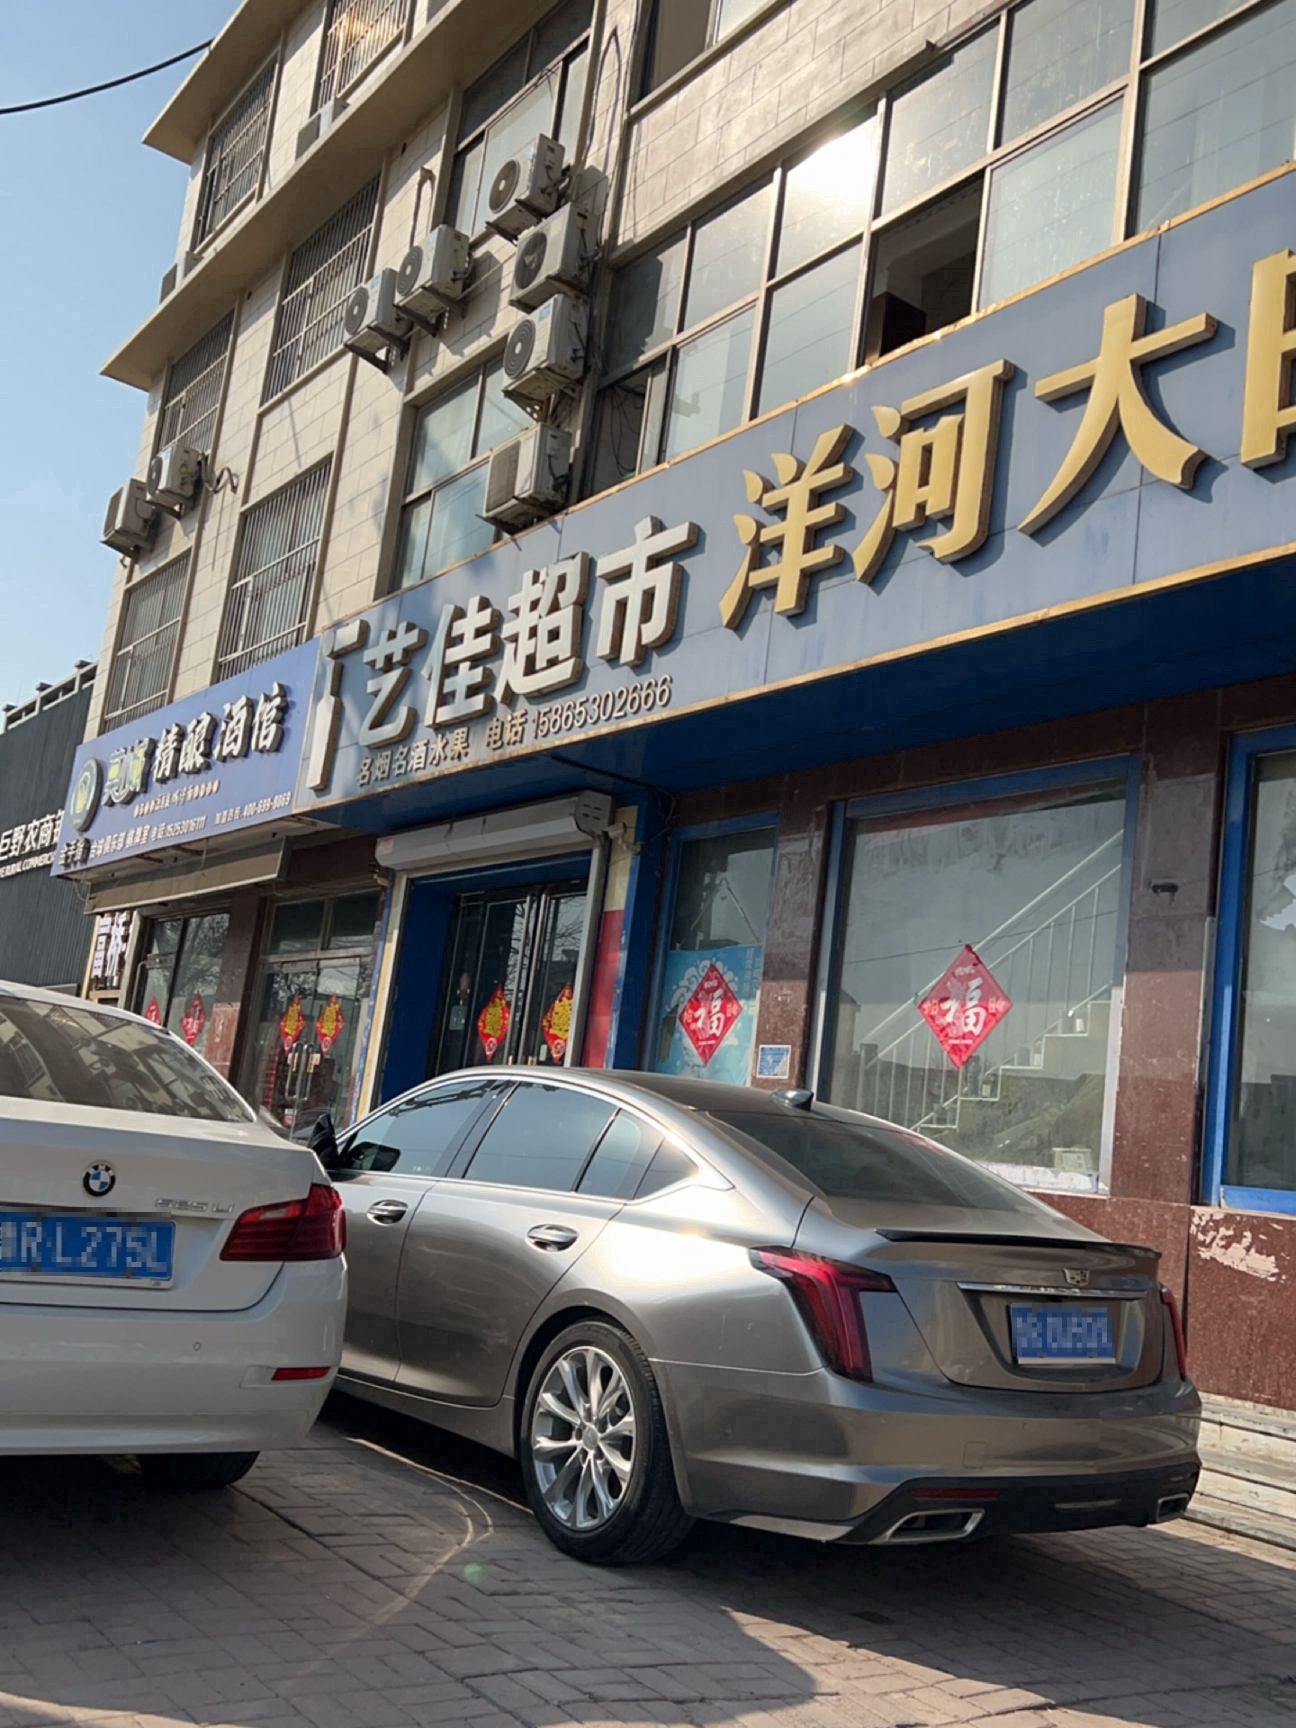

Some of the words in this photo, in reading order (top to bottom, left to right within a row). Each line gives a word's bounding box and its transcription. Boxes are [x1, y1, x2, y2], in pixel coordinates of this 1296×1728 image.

[356, 726, 471, 787] 名烟名酒水果
[485, 708, 529, 751] 电话
[533, 674, 674, 739] 15865302666
[690, 987, 725, 1040] 福
[936, 977, 988, 1038] 福
